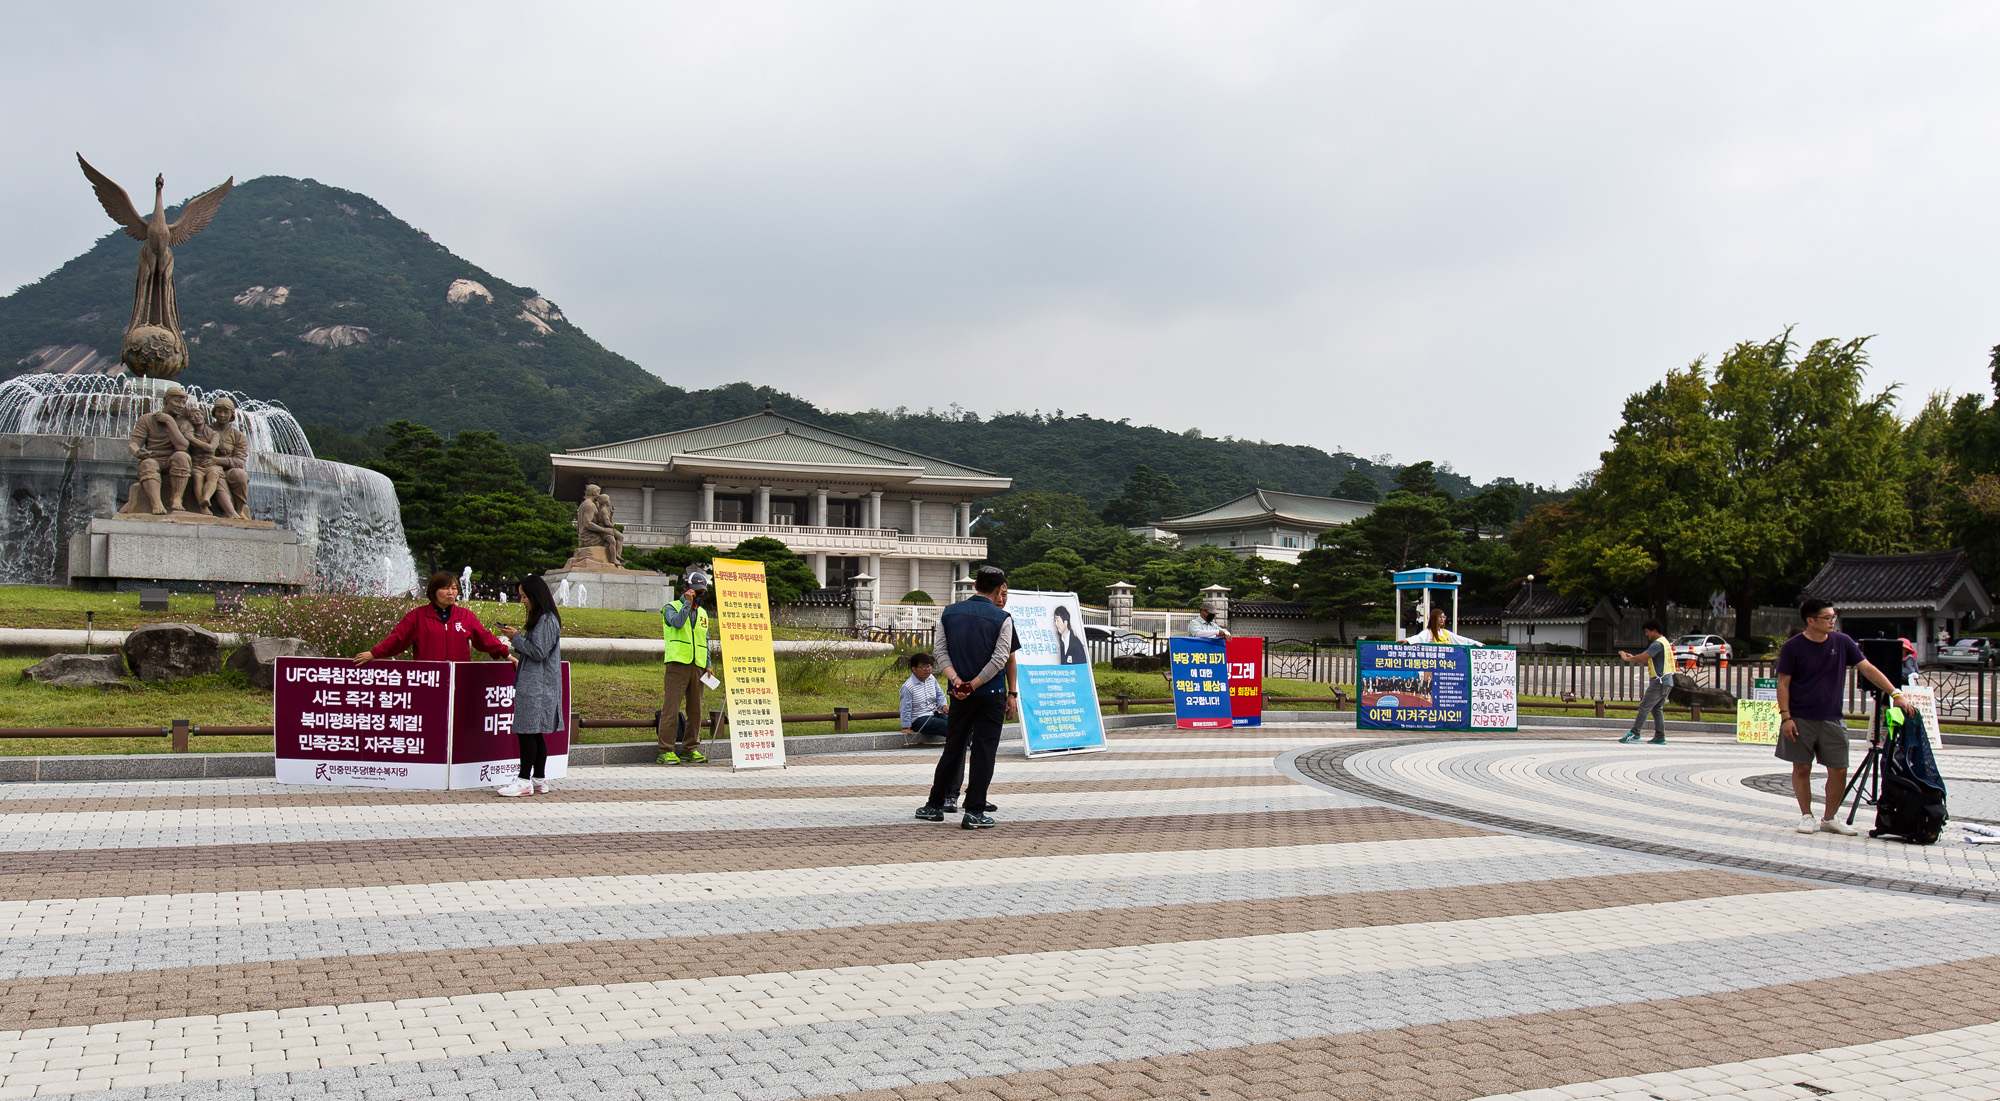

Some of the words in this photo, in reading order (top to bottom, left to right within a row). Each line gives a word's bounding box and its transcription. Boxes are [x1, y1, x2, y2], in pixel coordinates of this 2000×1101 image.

[715, 571, 738, 581] 노량진본동
[738, 572, 766, 584] 지역주택조합
[722, 590, 737, 598] 문재인
[1173, 652, 1190, 664] 부당
[1191, 652, 1208, 664] 계약
[1208, 652, 1226, 664] 파기
[1490, 651, 1502, 660] 하는
[1504, 651, 1514, 661] 교섭
[1376, 658, 1402, 668] 문재인
[1404, 658, 1437, 669] 대통령의
[1439, 660, 1456, 670] 약속!
[286, 667, 402, 686] UFG북침전쟁연습
[406, 670, 440, 687] 반대!
[1190, 669, 1198, 678] 에
[1200, 668, 1213, 678] 대한
[1176, 680, 1200, 692] 책임과
[1202, 680, 1226, 692] 배상을
[1238, 686, 1258, 696] 회장님!
[312, 690, 342, 706] 사드
[346, 690, 375, 708] 즉각
[378, 692, 412, 708] 철거!
[485, 686, 516, 708] 전쟁
[1186, 696, 1220, 706] 요구합니다!
[1370, 708, 1392, 722] 이젠
[1396, 709, 1462, 722] 지켜주십시오!!
[301, 712, 385, 730] 북미평화협정
[389, 714, 422, 732] 체결!
[484, 714, 514, 736] 미국
[299, 734, 359, 752] 민족공조!
[364, 736, 424, 754] 자주통일!
[329, 765, 408, 776] 민중민주당(환수복지당)
